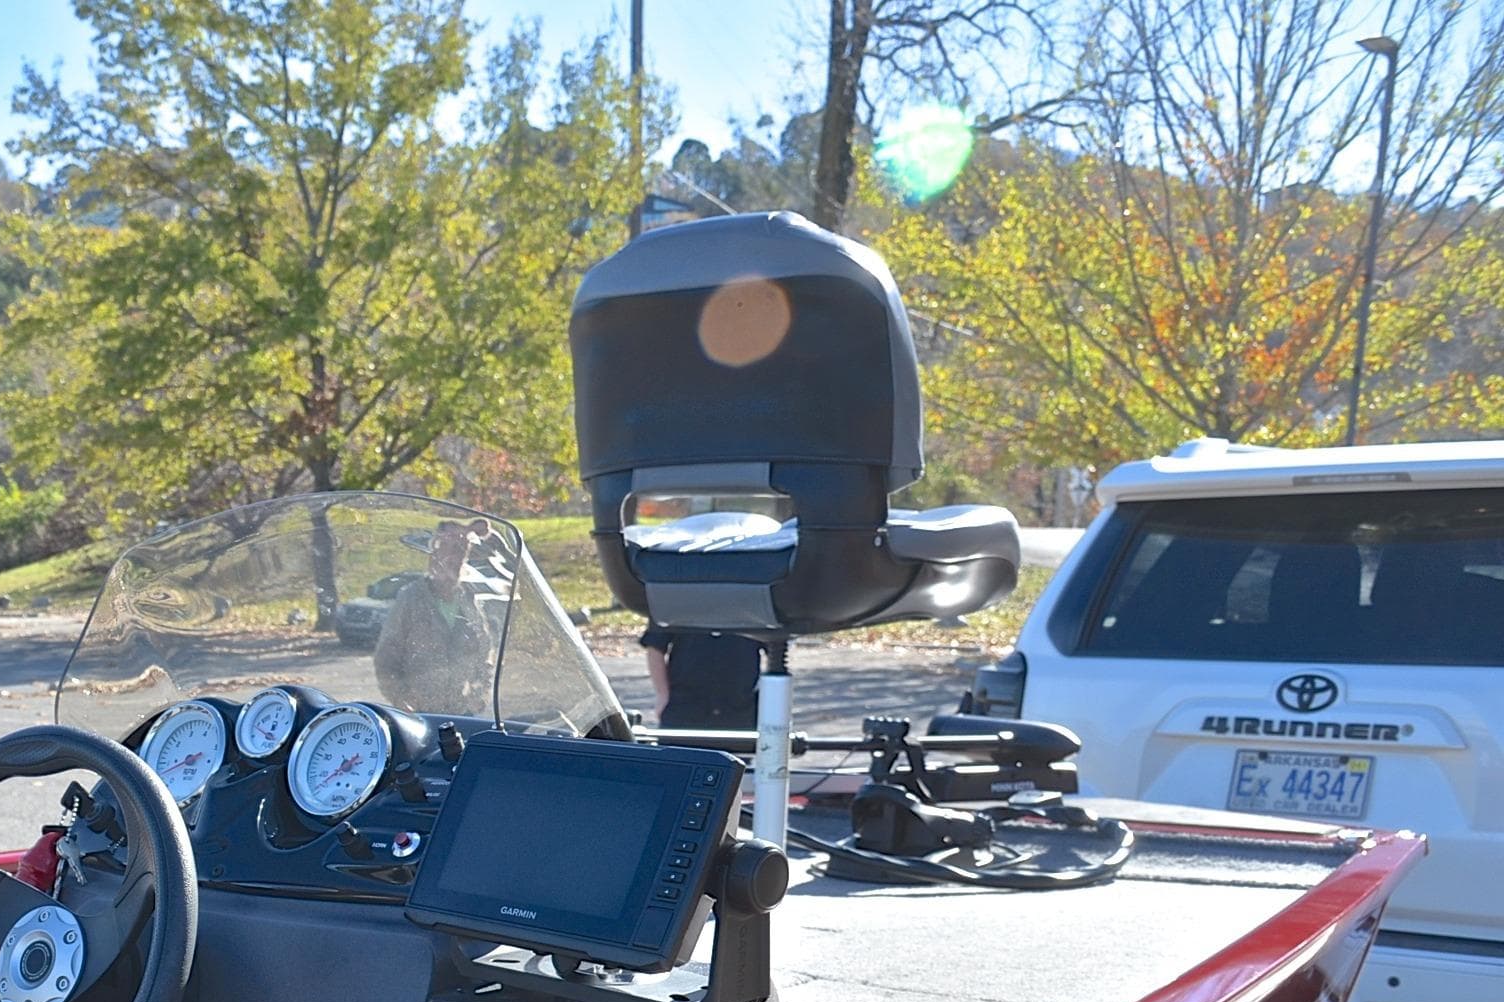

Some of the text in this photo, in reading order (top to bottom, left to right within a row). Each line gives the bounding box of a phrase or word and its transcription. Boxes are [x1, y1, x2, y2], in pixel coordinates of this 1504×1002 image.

[1281, 769, 1365, 803] 44347
[1273, 799, 1299, 811] CAR
[1306, 803, 1359, 815] DEALER
[500, 905, 537, 920] GARMIN
